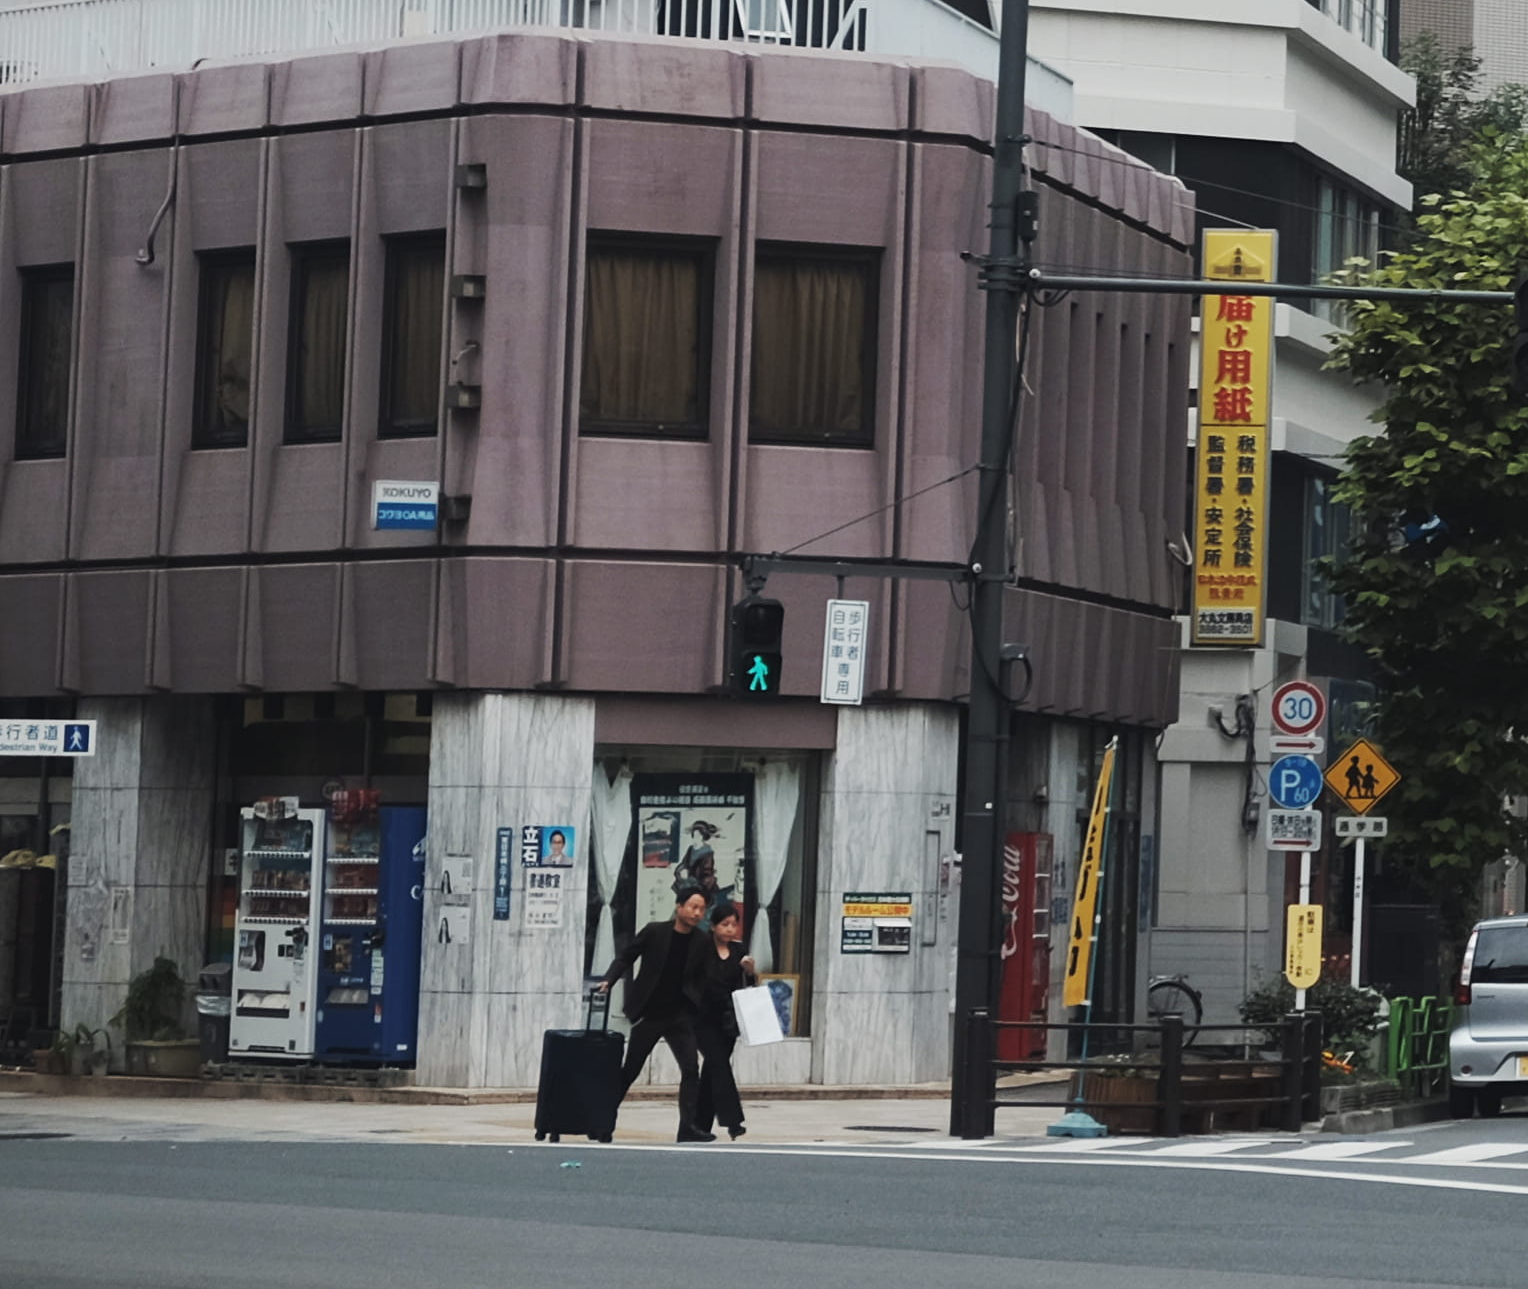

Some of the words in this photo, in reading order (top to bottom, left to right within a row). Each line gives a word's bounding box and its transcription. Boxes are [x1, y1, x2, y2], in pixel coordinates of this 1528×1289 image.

[1214, 295, 1256, 422] 届け用紙
[382, 487, 431, 498] KOKUYO
[1202, 435, 1225, 568] 監督署・安定所
[1233, 435, 1256, 568] 税務署・社会保険
[831, 610, 845, 658] 自転車
[848, 611, 861, 660] 歩行者
[836, 663, 849, 694] 専用
[1284, 697, 1312, 720] 30
[0, 725, 58, 741] 行者道
[39, 743, 57, 754] Way
[1281, 770, 1301, 802] P
[1339, 820, 1384, 833] 通学路
[523, 827, 539, 862] 立石
